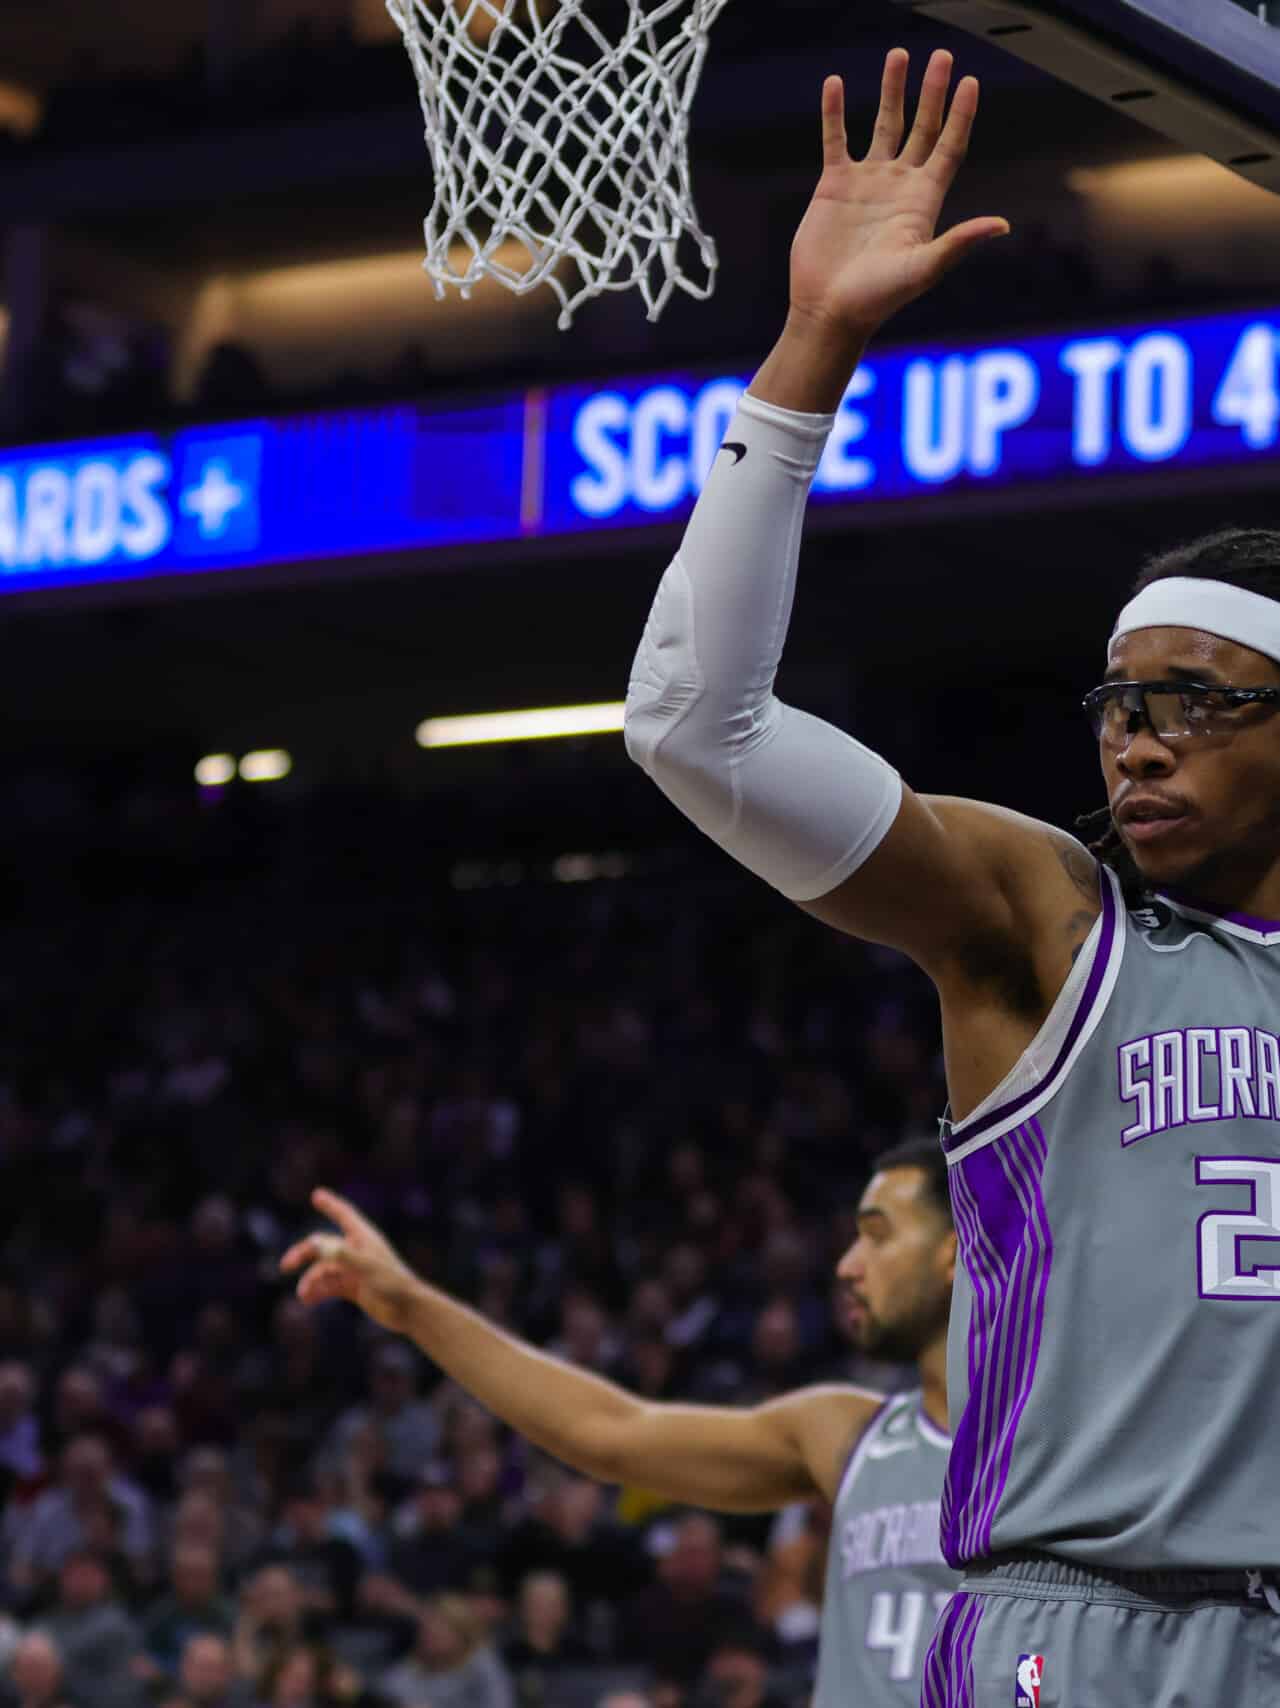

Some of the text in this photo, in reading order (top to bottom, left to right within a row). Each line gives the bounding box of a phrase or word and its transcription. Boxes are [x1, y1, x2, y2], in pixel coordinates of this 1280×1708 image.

[572, 363, 877, 518] SCOE
[902, 351, 1037, 481] UP
[1061, 333, 1191, 466] TO
[866, 1591, 952, 1680] 4
